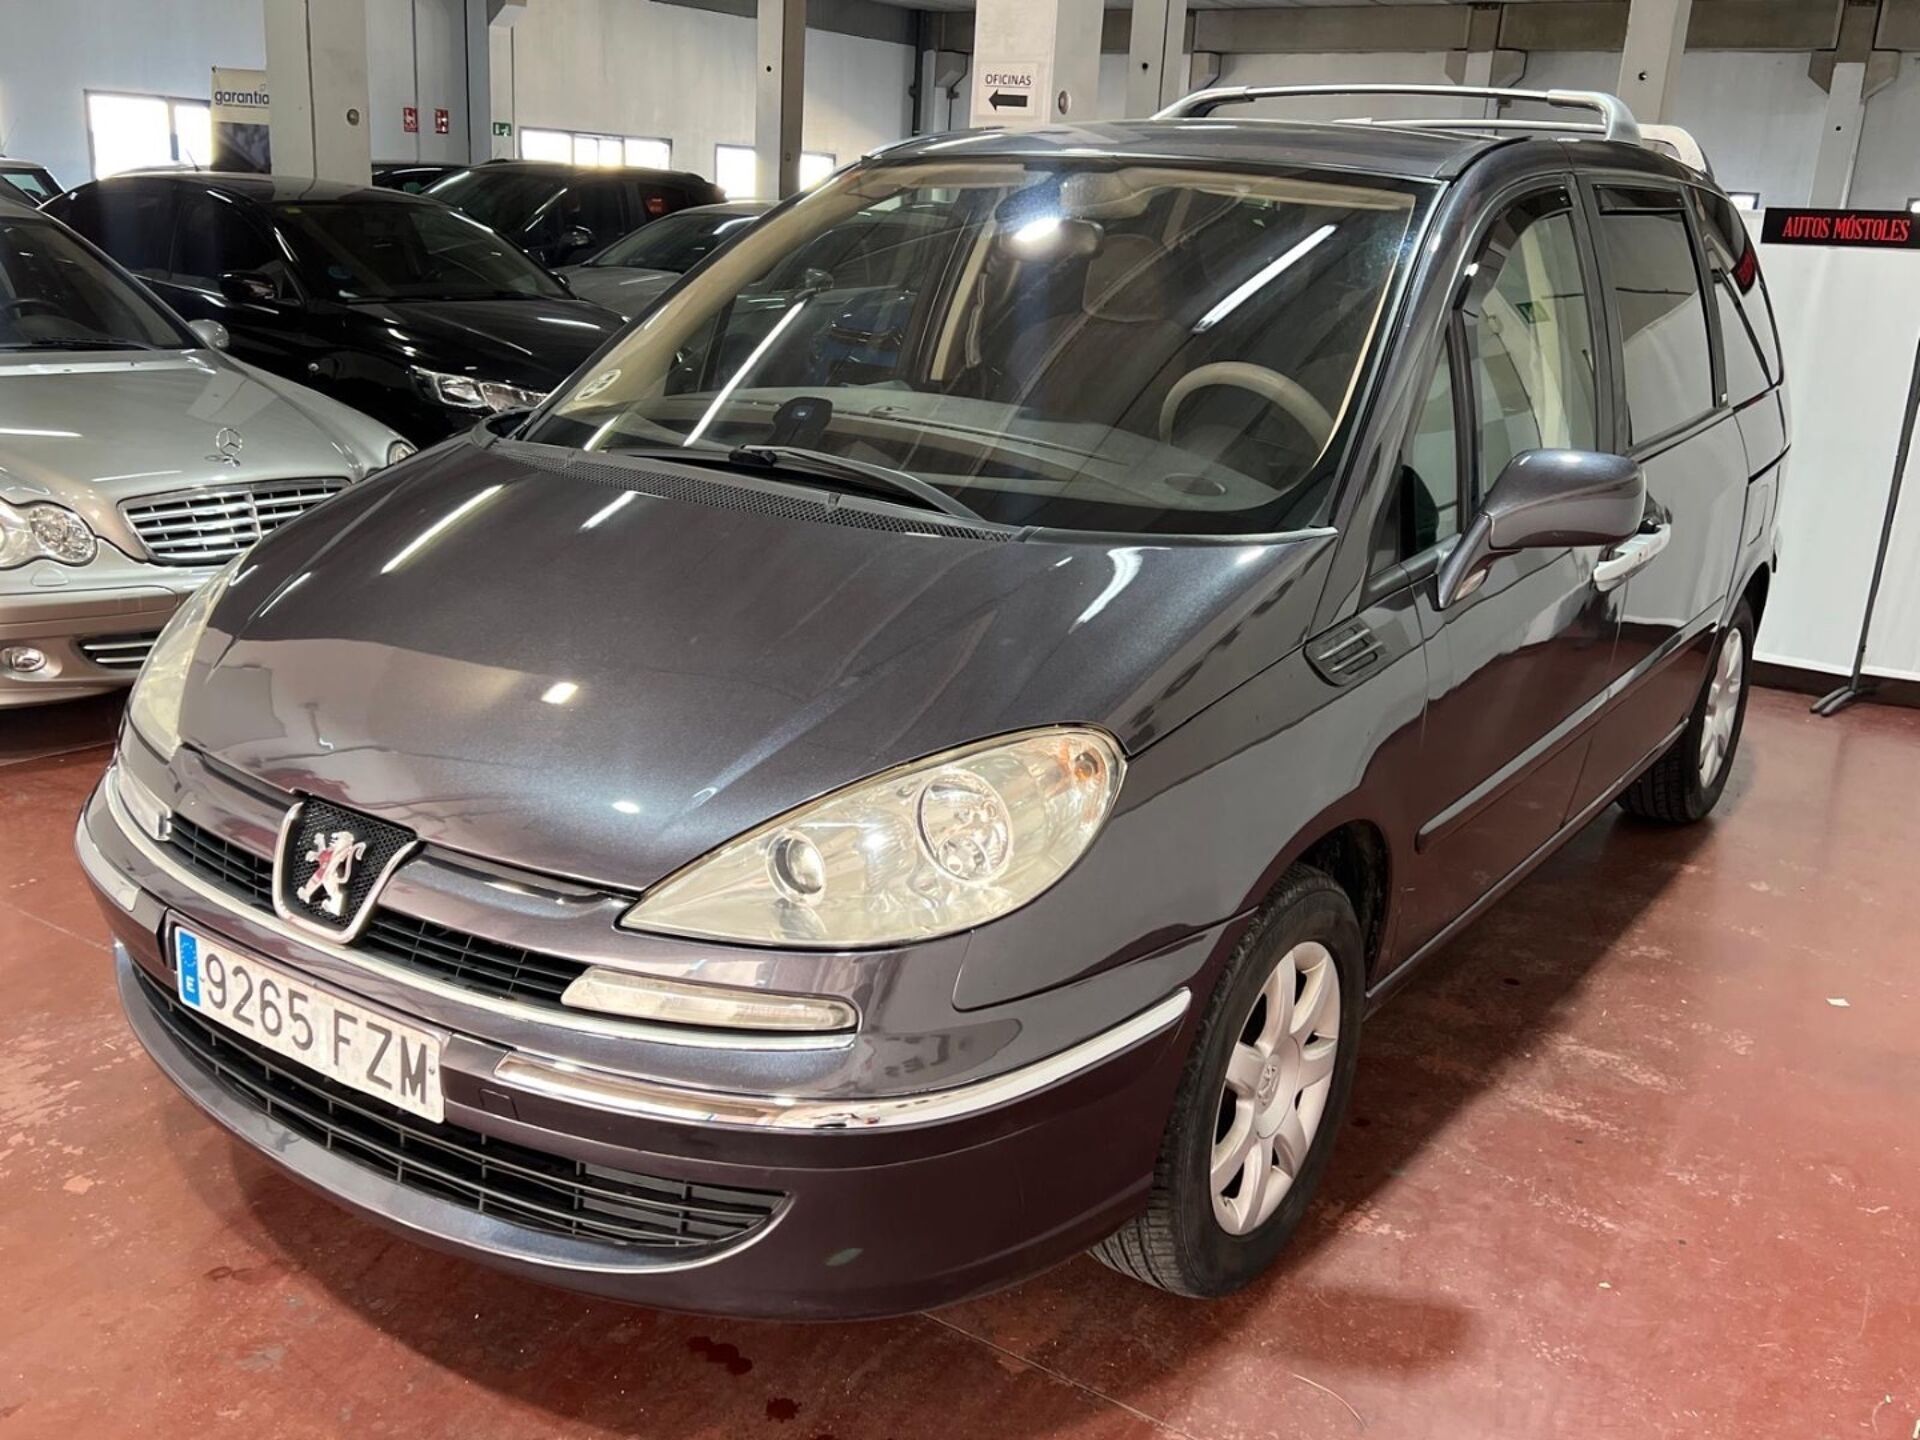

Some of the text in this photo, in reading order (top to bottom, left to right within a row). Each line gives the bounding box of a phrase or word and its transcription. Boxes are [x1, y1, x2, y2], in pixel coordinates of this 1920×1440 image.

[985, 74, 1032, 86] OFICINAS
[1782, 214, 1911, 242] AUTOS MÓSTOLES
[186, 976, 196, 992] E
[205, 953, 427, 1105] 9265 FZM
